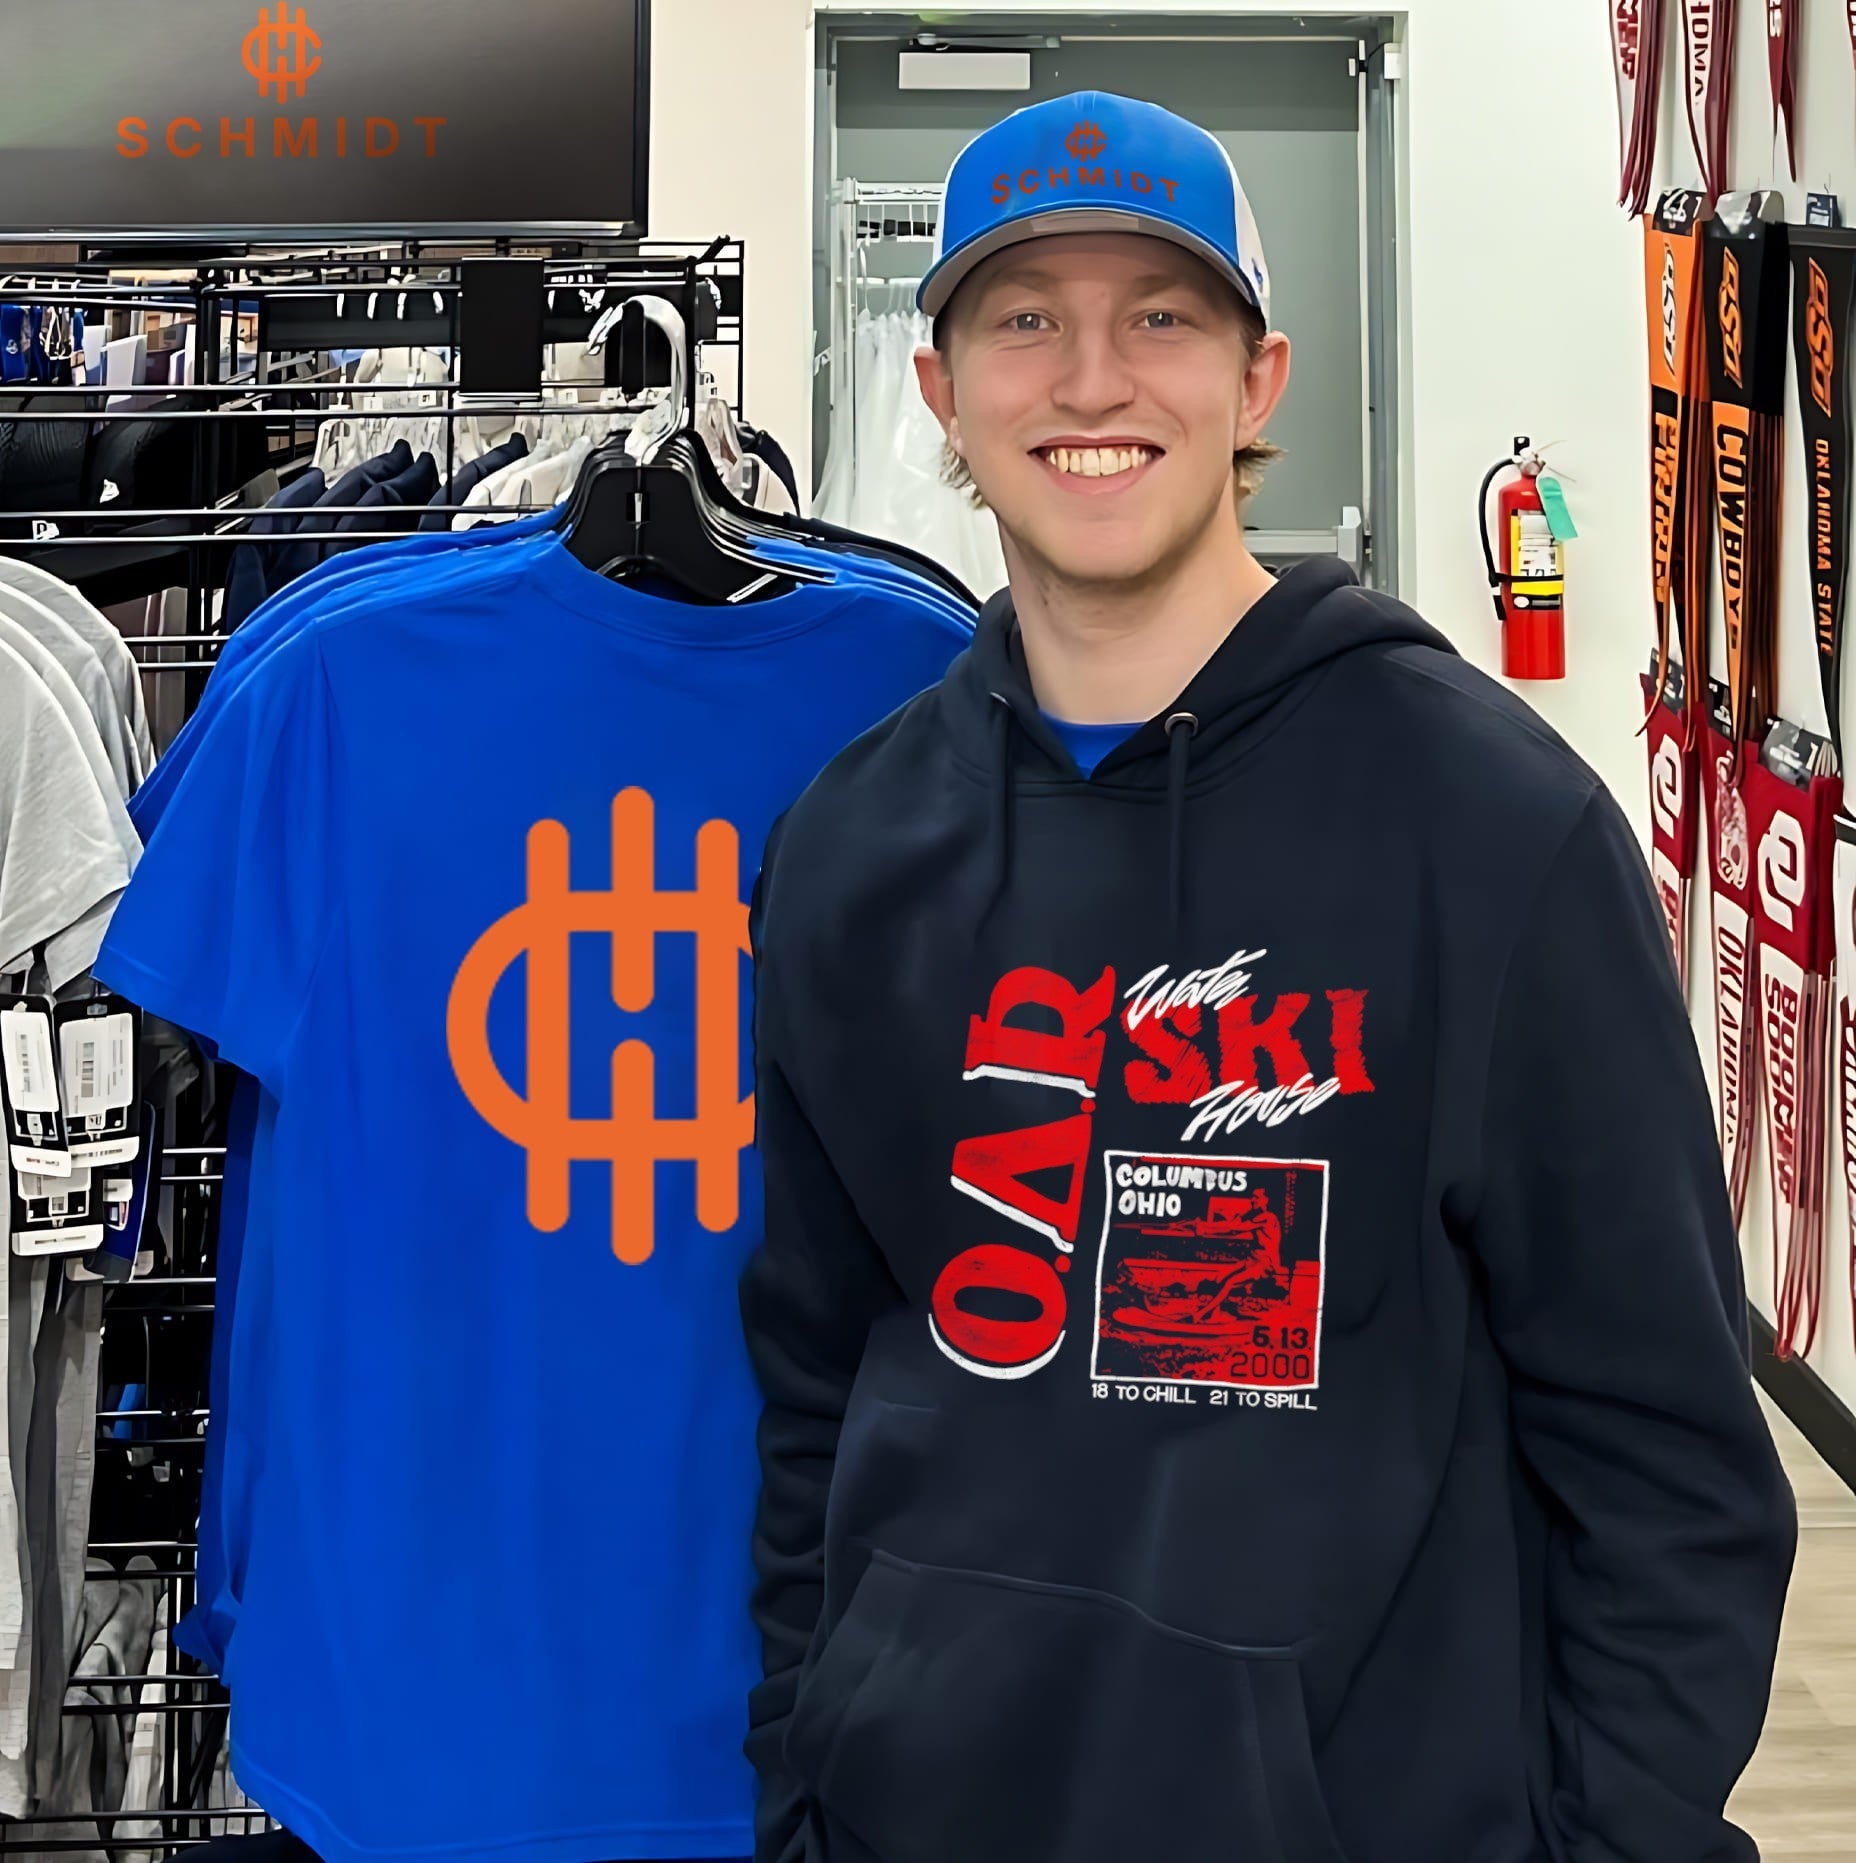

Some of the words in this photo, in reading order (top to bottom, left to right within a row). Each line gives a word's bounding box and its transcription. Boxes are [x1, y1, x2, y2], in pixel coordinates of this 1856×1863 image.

[115, 116, 447, 158] SCHMIDT
[991, 166, 1179, 204] SCHMIDT
[1815, 437, 1832, 570] OKLAHOMA
[1120, 988, 1376, 1105] SKI
[1718, 926, 1745, 1145] OKLAHOMA
[1115, 1163, 1248, 1192] COLUMBUS
[1117, 1189, 1182, 1217] OHIO
[1230, 1353, 1310, 1379] 2000
[1091, 1383, 1109, 1399] 18
[1115, 1385, 1140, 1401] TO
[1143, 1385, 1197, 1405] CHILL
[1209, 1390, 1229, 1407] 21
[1235, 1391, 1261, 1408] TO
[1264, 1392, 1318, 1411] SPILL
